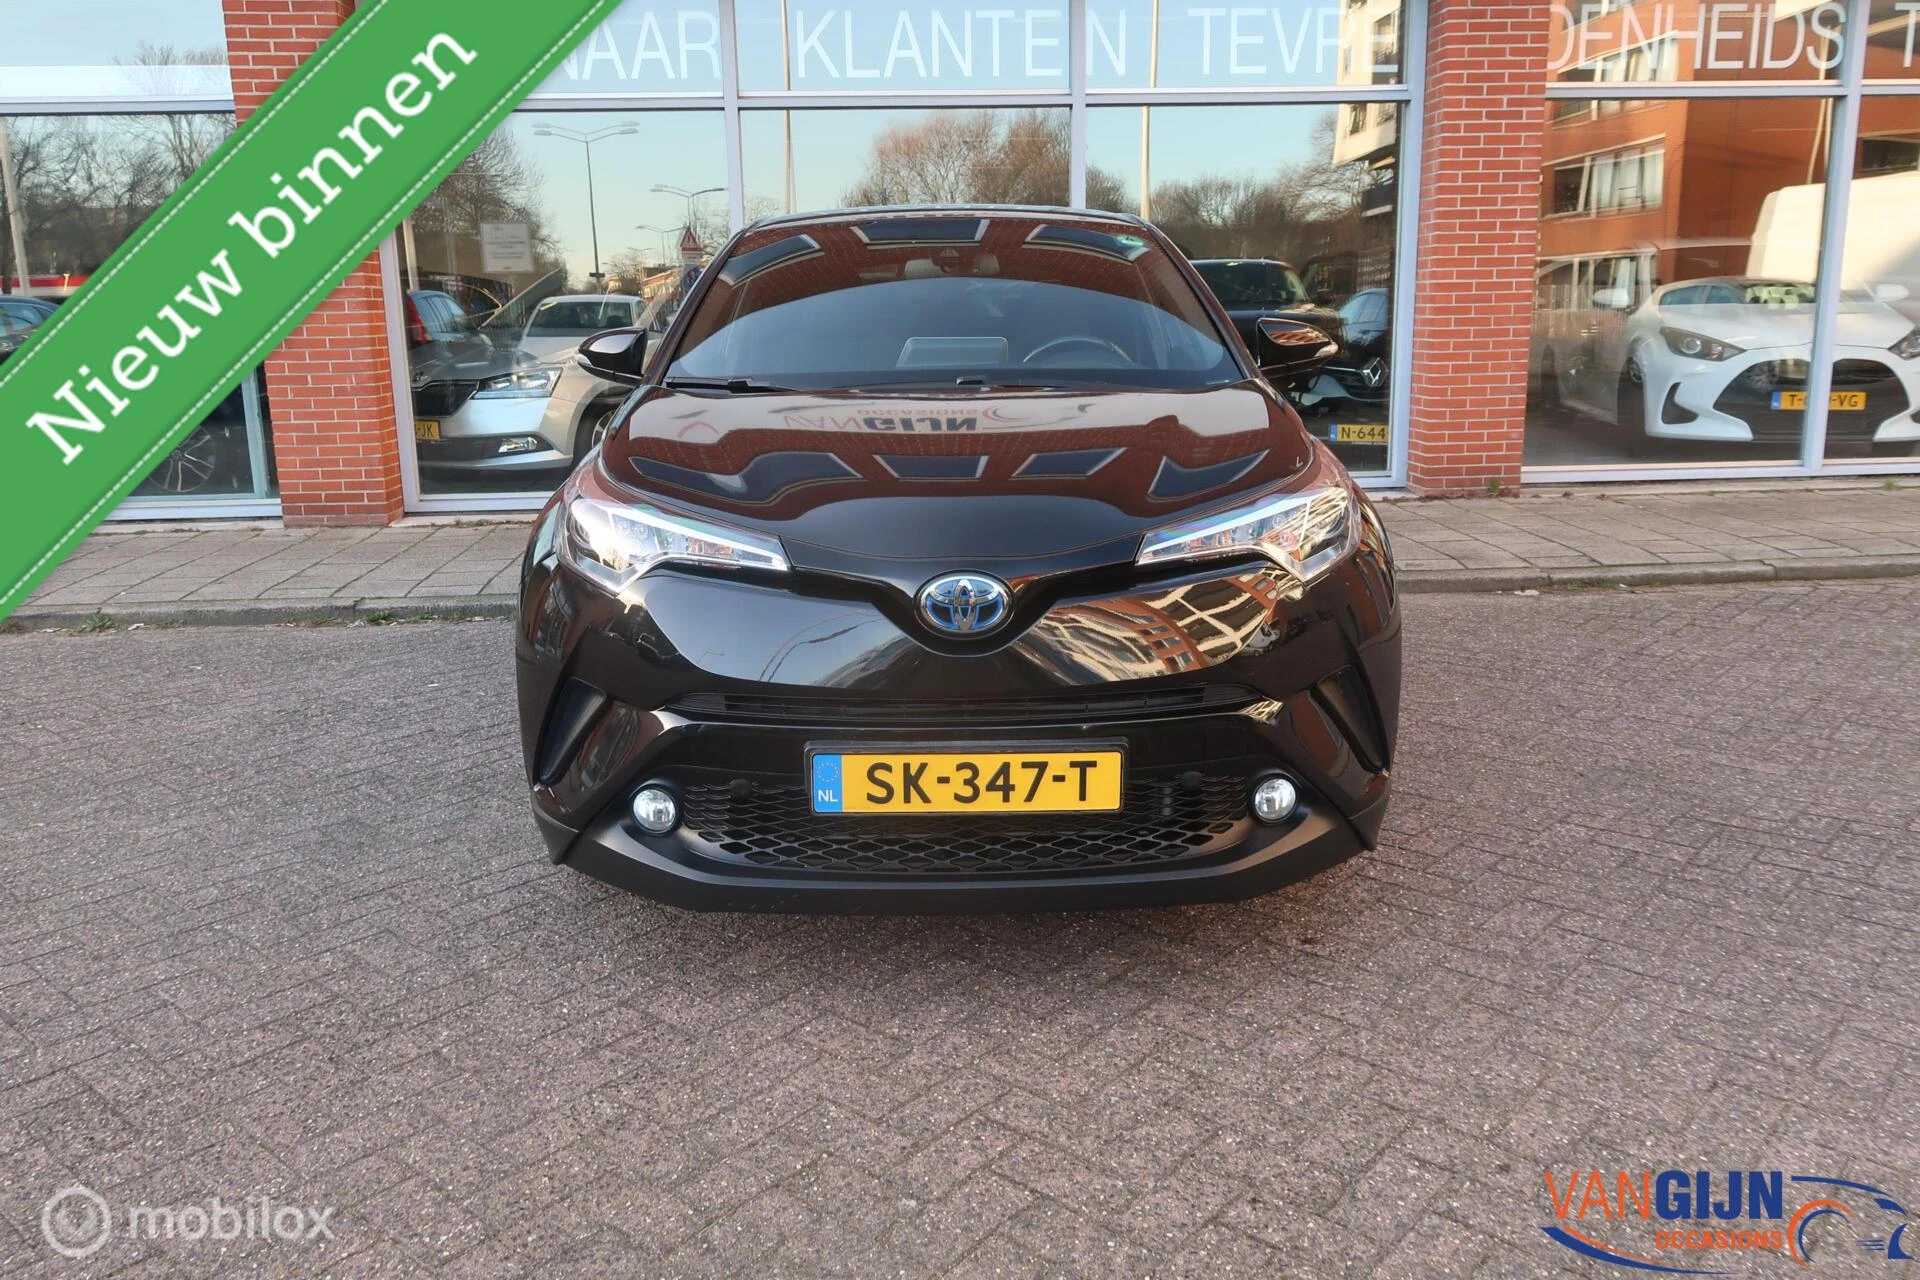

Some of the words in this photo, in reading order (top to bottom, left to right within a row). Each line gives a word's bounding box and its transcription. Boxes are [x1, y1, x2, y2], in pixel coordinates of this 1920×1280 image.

[1789, 393, 1858, 408] T--VG
[866, 760, 1098, 805] SK-347-T
[817, 789, 839, 803] NL
